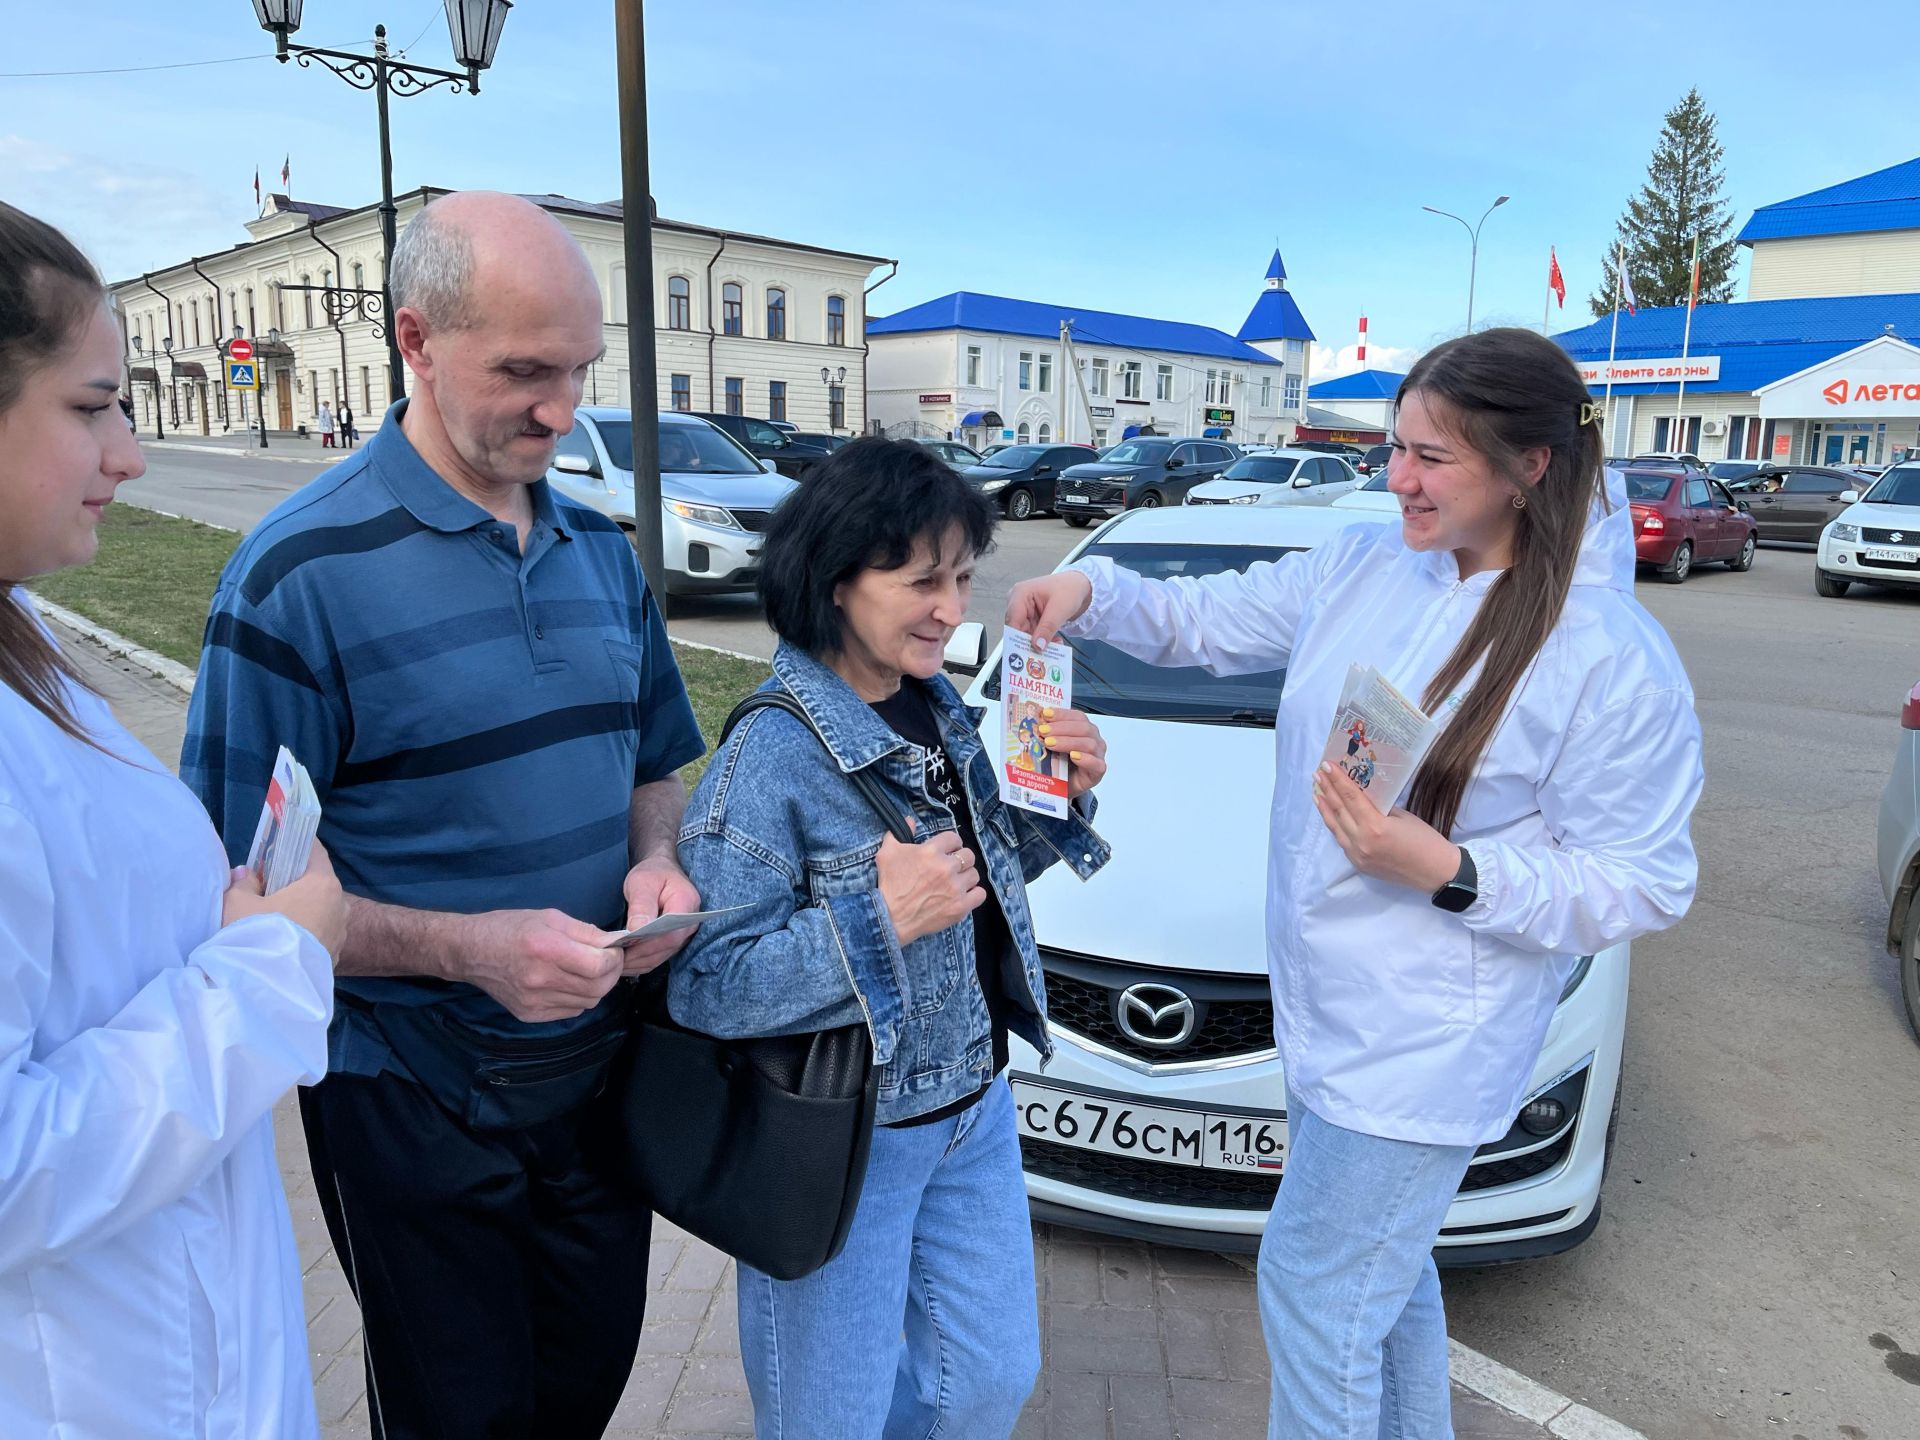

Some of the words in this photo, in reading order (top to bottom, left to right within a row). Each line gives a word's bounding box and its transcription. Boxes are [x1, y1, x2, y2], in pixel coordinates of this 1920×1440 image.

[1008, 672, 1064, 700] ПАМЯТКА
[1012, 766, 1055, 786] Безопасность
[1017, 777, 1026, 785] на
[1027, 780, 1049, 791] дороге
[1209, 1120, 1276, 1155] 116
[1222, 1152, 1256, 1166] RUS
